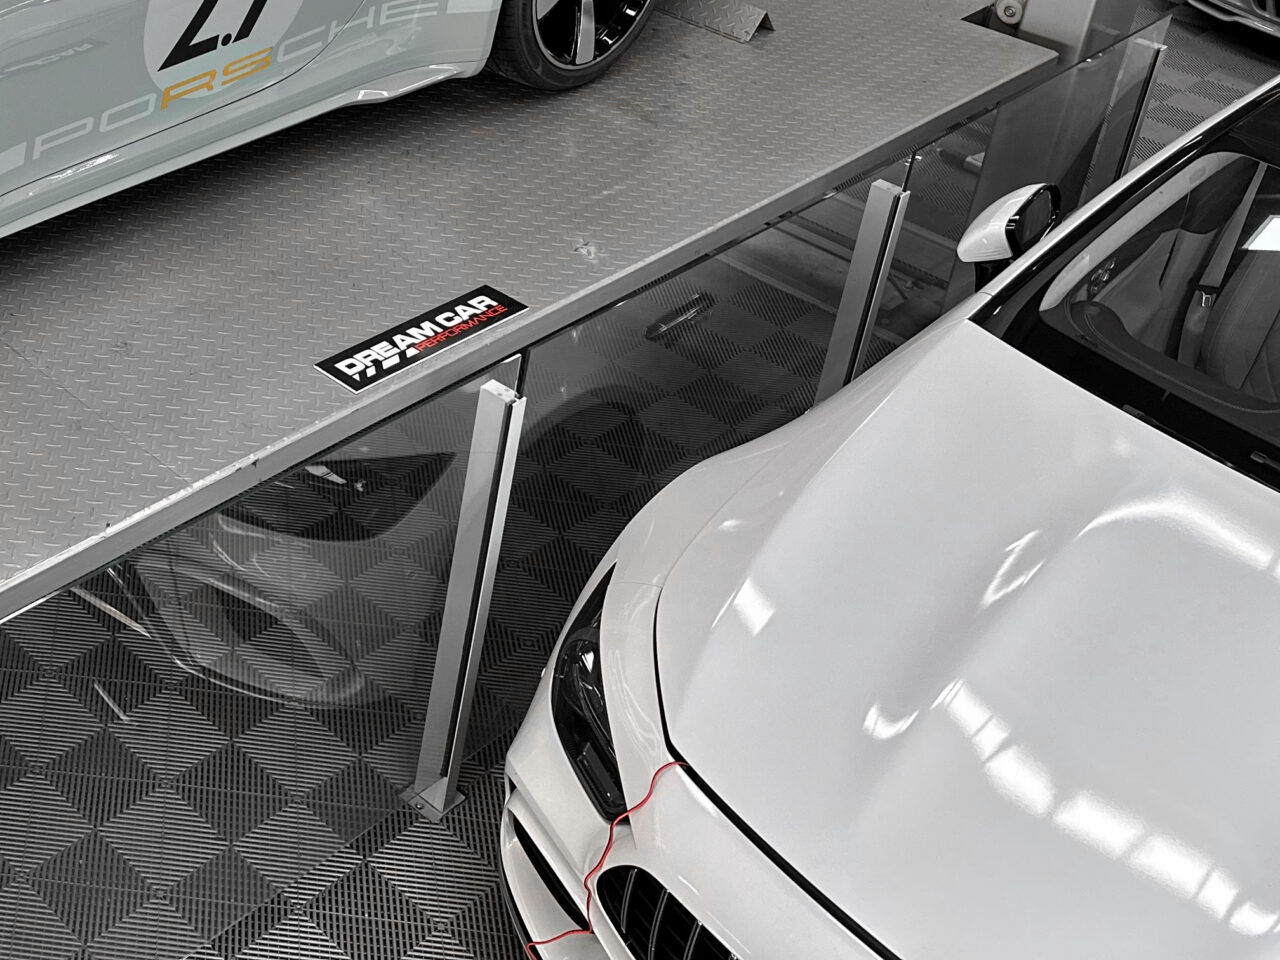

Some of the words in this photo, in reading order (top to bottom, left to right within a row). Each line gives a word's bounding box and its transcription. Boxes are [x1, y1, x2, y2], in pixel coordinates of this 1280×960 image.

[334, 320, 443, 377] DREAM
[435, 295, 498, 327] CAR
[414, 304, 508, 352] PERFORMANCE
